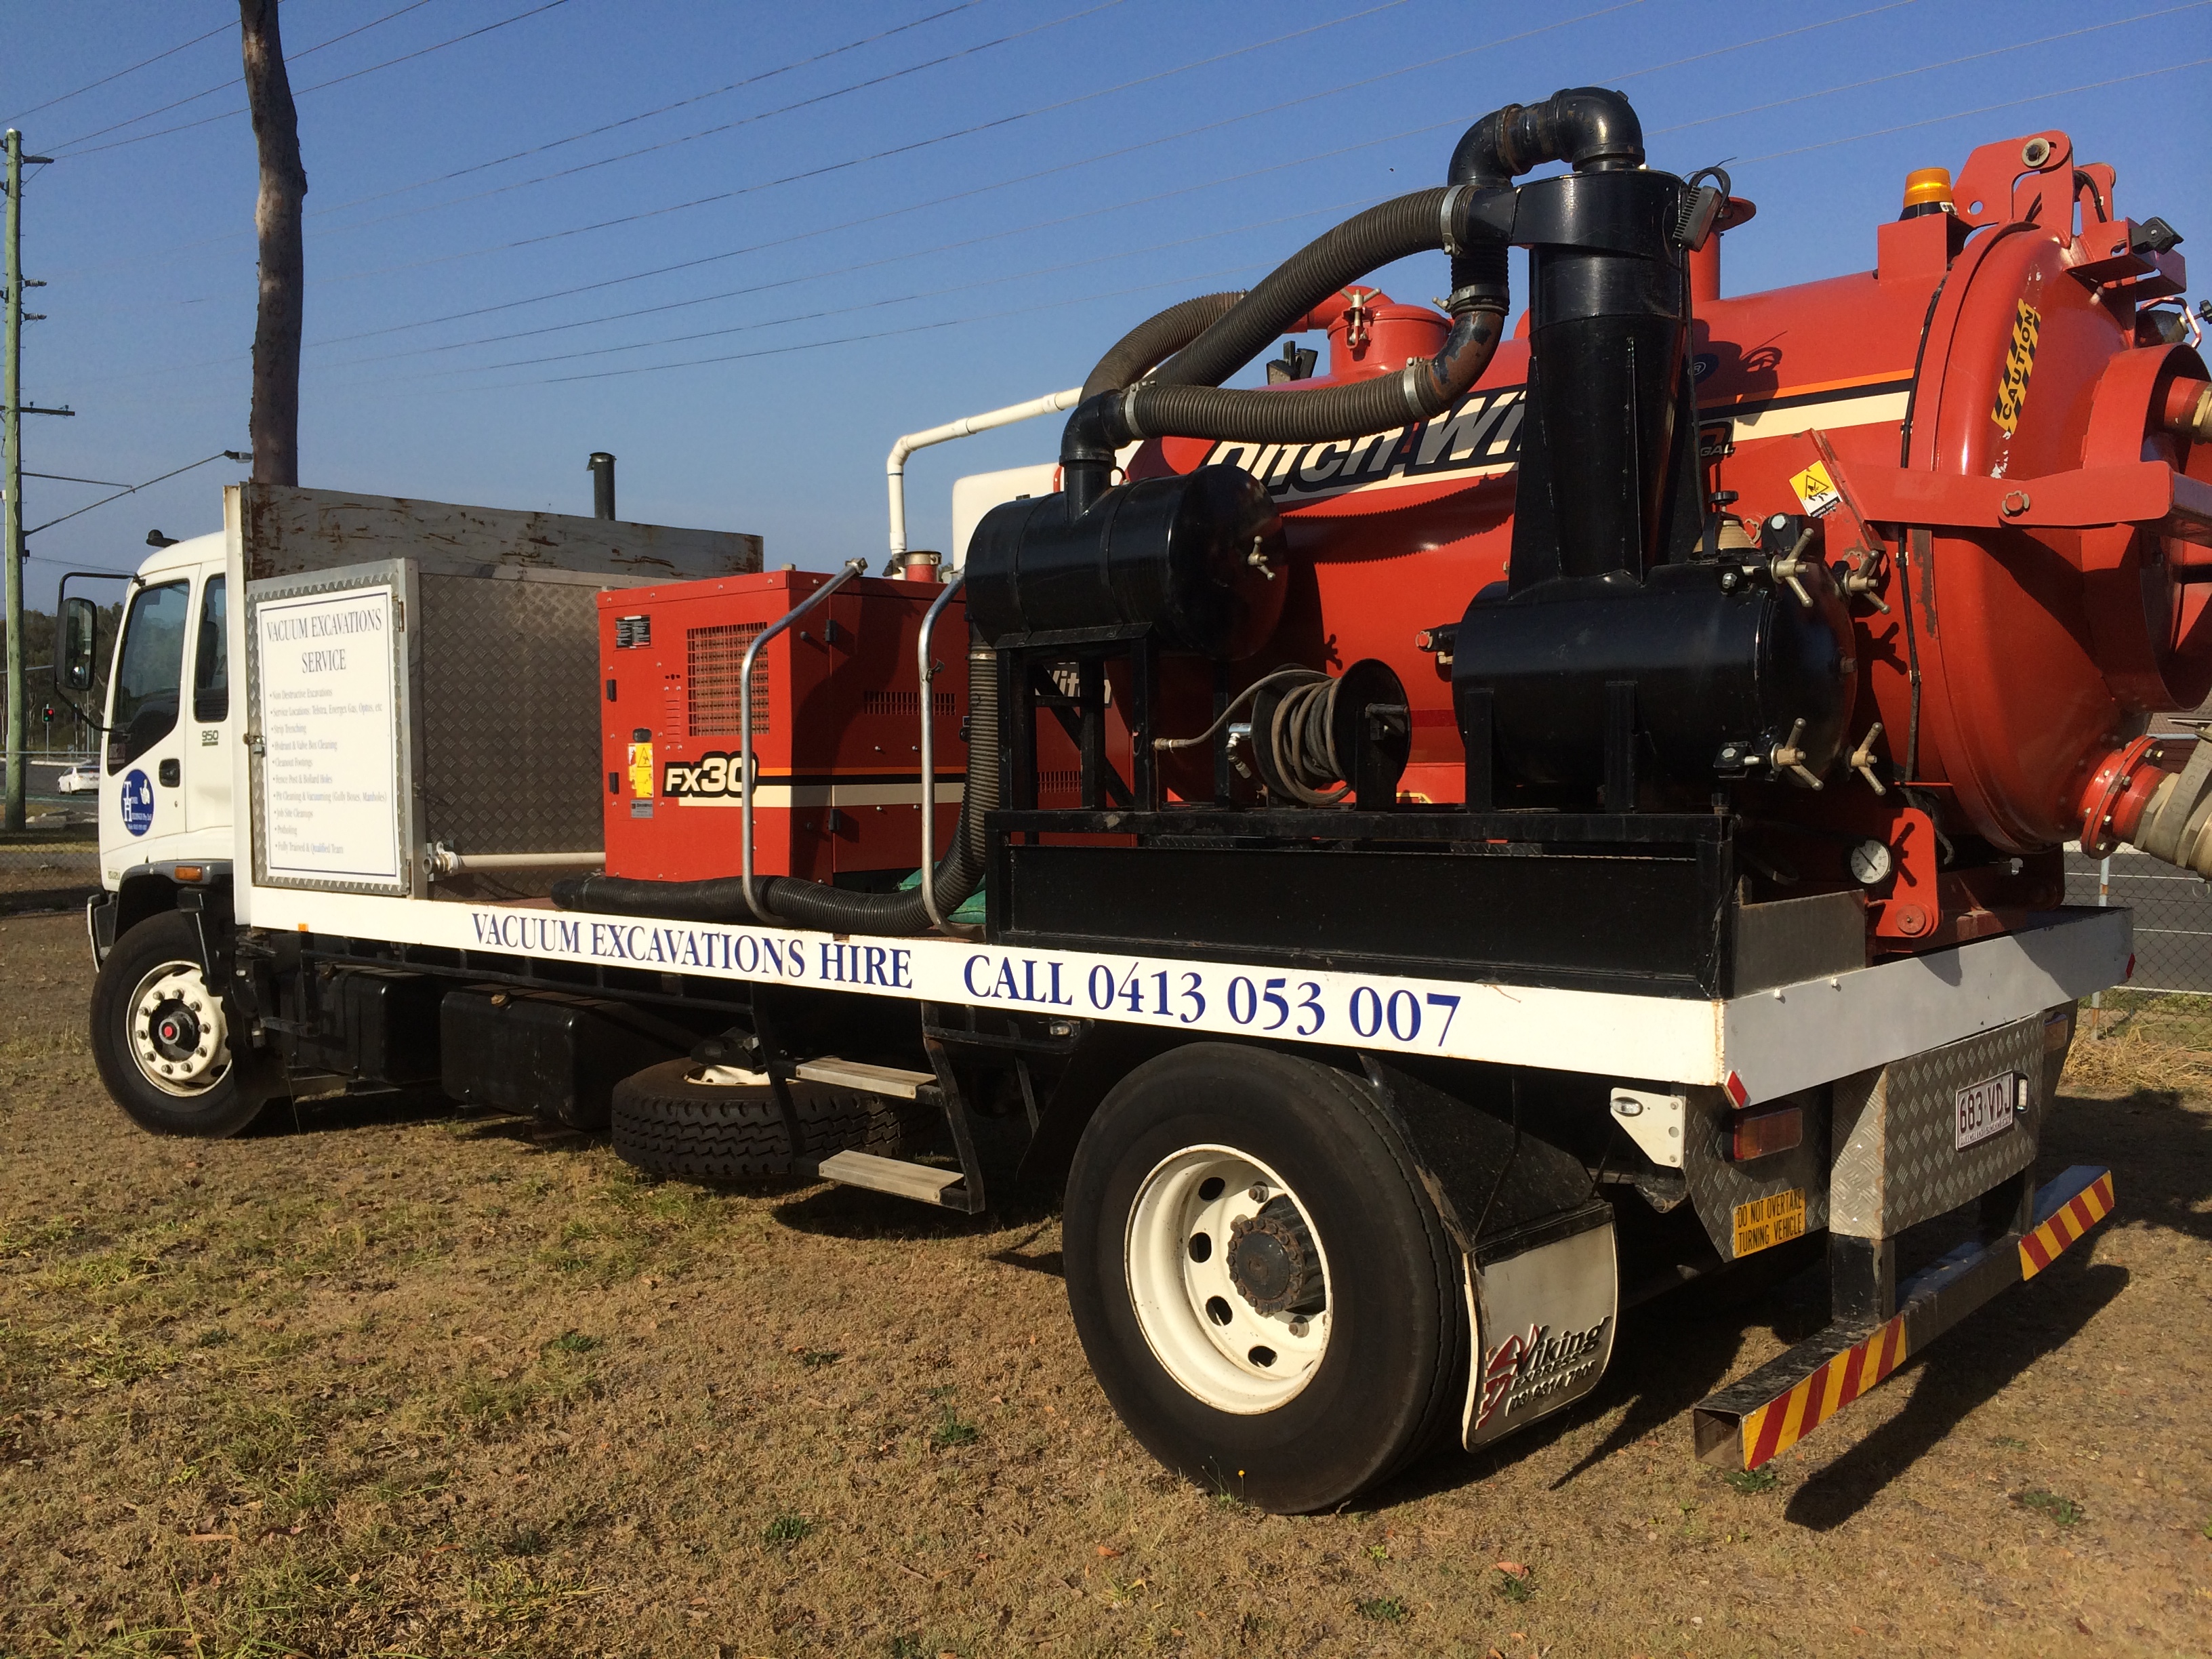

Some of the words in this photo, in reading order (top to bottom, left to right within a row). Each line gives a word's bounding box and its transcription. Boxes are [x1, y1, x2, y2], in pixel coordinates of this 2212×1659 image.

[2002, 308, 2034, 420] CAUTION
[1700, 444, 1734, 457] GAL
[266, 617, 308, 642] VACUUM
[311, 608, 382, 637] EXCAVATIONS
[302, 649, 346, 674] SERVICE
[282, 690, 306, 699] Destructive
[307, 689, 333, 698] Excavations
[665, 757, 756, 792] FX30
[472, 913, 581, 954] VACUUM
[590, 923, 806, 977] EXCAVATIONS
[818, 942, 913, 989] HIRE
[963, 954, 1073, 1006] CALL
[1088, 961, 1206, 1023] 0413
[1227, 976, 1326, 1036] 053
[1348, 985, 1462, 1047] 007
[1738, 1205, 1748, 1229] DO
[1750, 1200, 1764, 1225] NOT
[1767, 1188, 1802, 1219] OVERTAKE
[1738, 1224, 1769, 1254] TURNING
[1773, 1212, 1802, 1242] VEHICLE
[1513, 1315, 1613, 1376] Viking
[1510, 1351, 1580, 1391] EXPRESS
